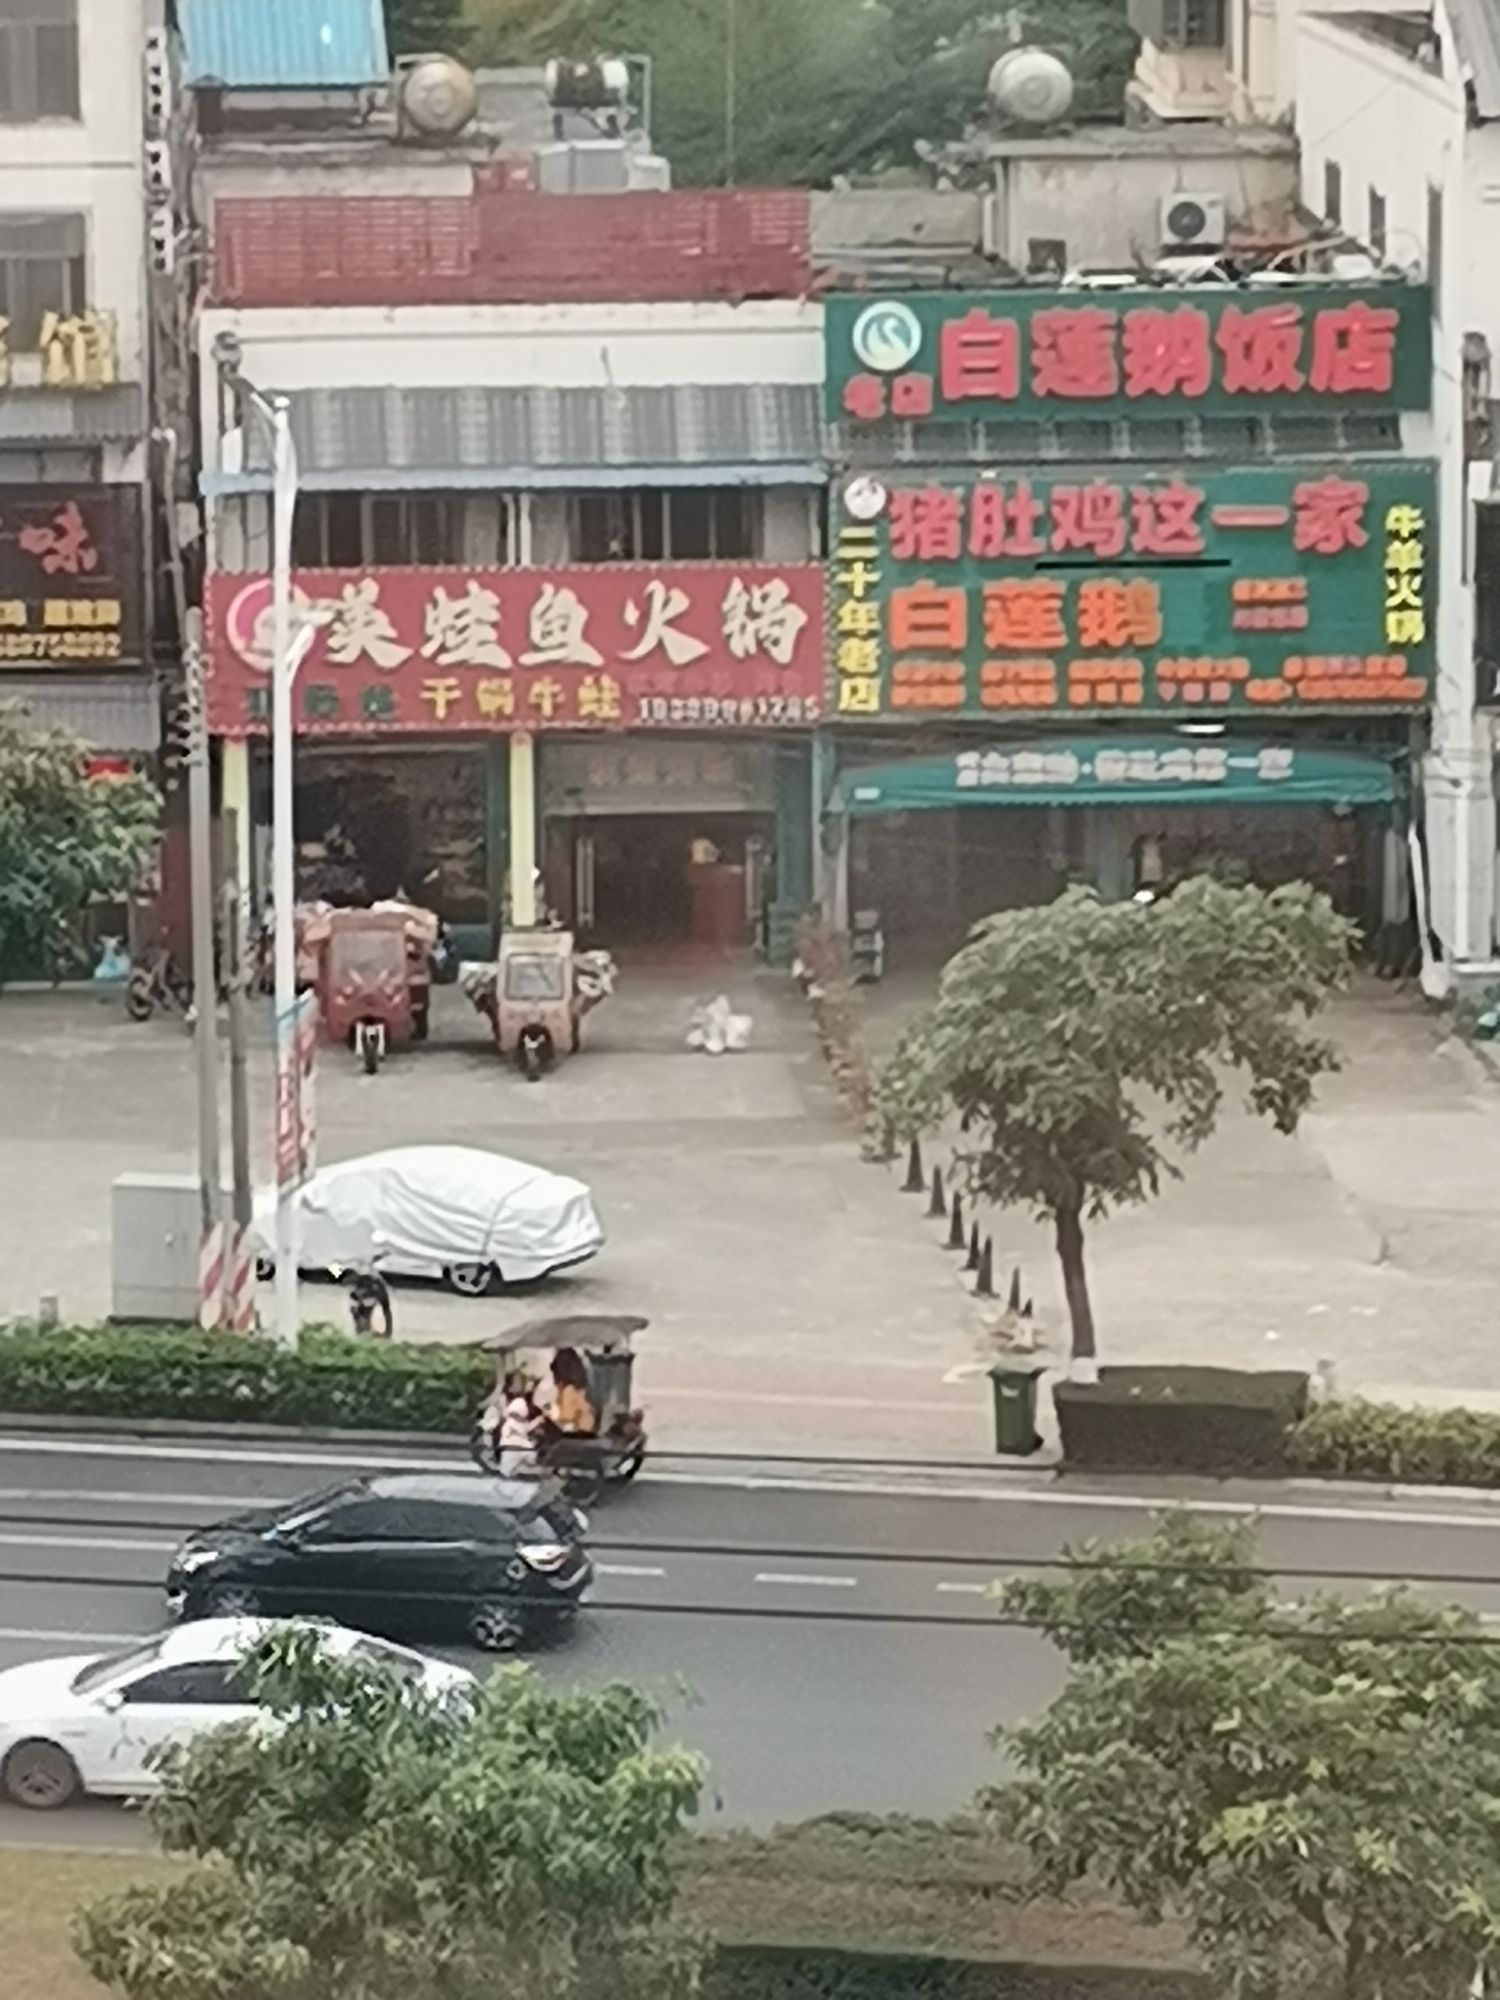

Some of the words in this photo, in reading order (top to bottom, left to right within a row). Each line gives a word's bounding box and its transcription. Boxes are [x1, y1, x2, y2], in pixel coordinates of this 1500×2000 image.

[939, 301, 1399, 399] 白莲鹅饭店
[889, 476, 1368, 561] 猪肚鸡这一家
[837, 526, 882, 713] 二十年老店
[889, 579, 1162, 651] 白莲鹅
